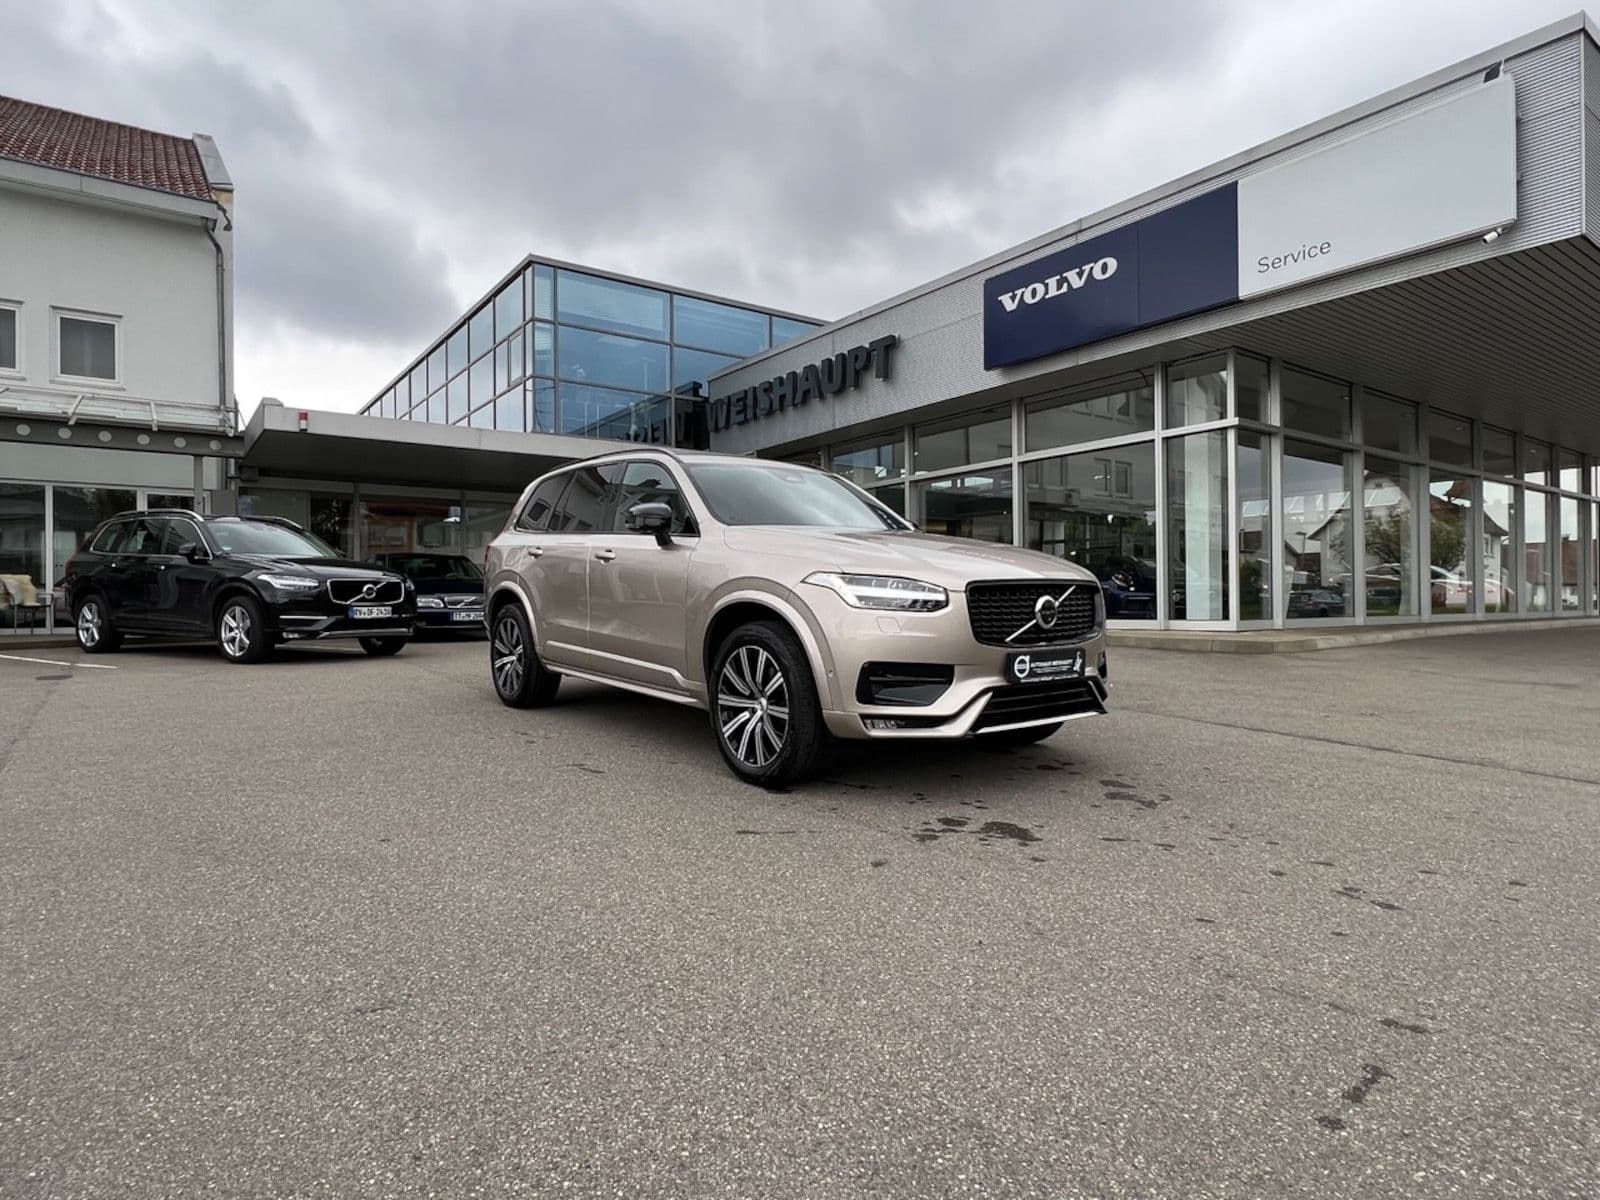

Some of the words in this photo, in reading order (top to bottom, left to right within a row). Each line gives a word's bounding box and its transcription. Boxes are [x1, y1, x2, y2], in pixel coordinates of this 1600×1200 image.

[998, 256, 1119, 313] VOLVO
[1257, 240, 1332, 274] Service
[705, 334, 897, 433] WEISHAUPT
